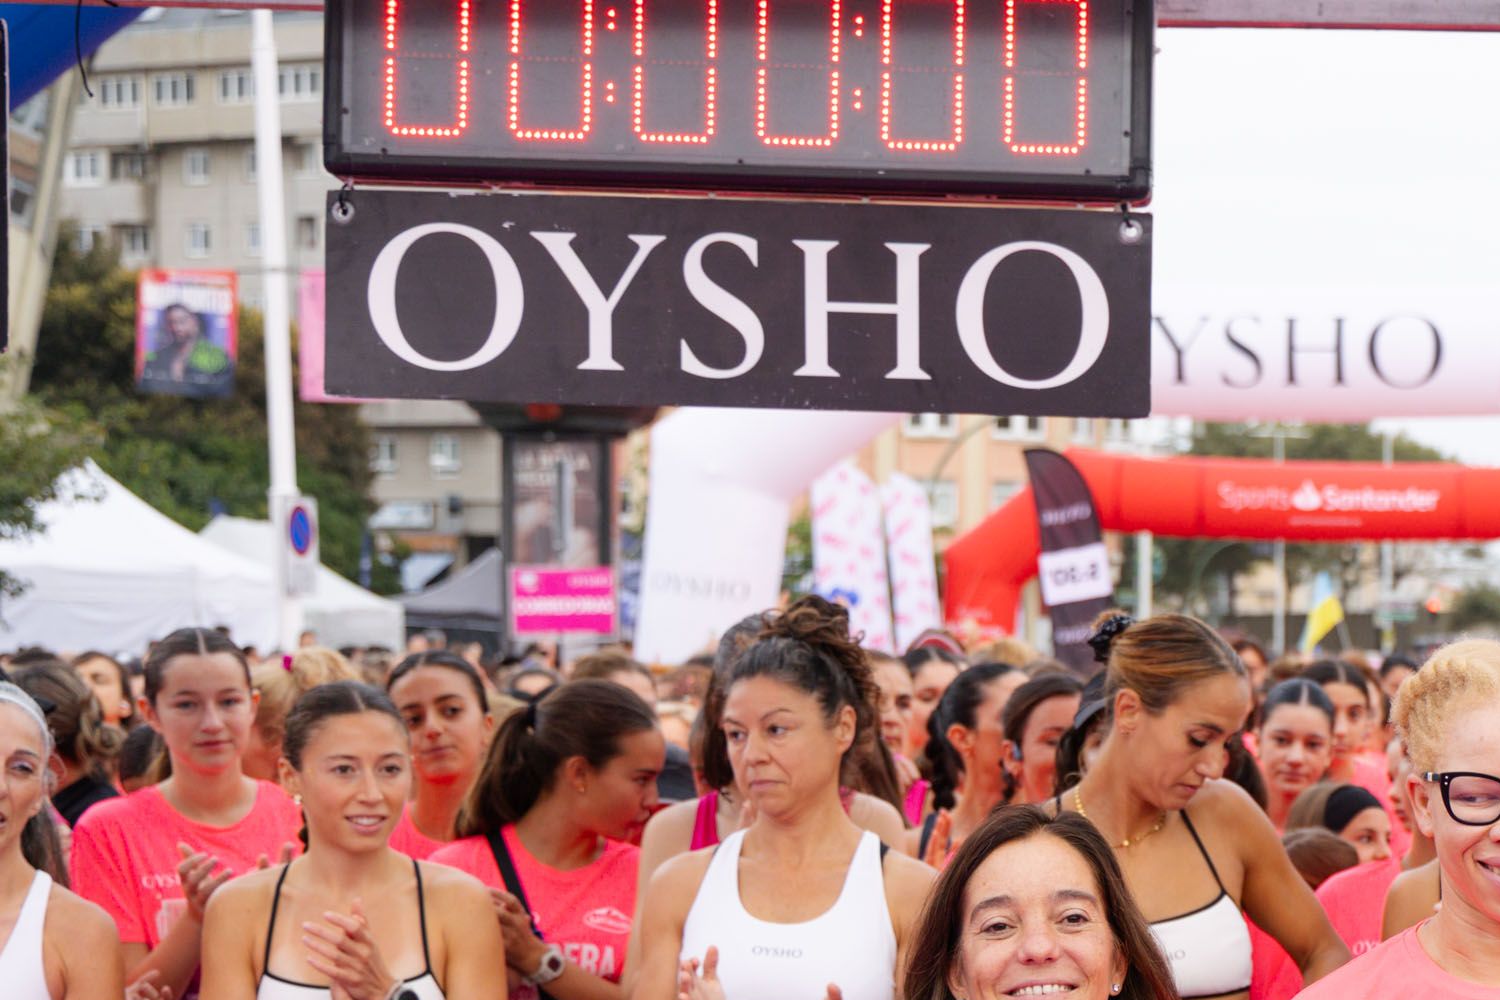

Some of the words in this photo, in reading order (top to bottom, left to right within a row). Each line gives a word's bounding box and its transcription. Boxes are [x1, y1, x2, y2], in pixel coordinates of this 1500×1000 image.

[367, 222, 1110, 390] OYSHO
[1217, 480, 1290, 512] Sports
[1322, 484, 1440, 512] Santander
